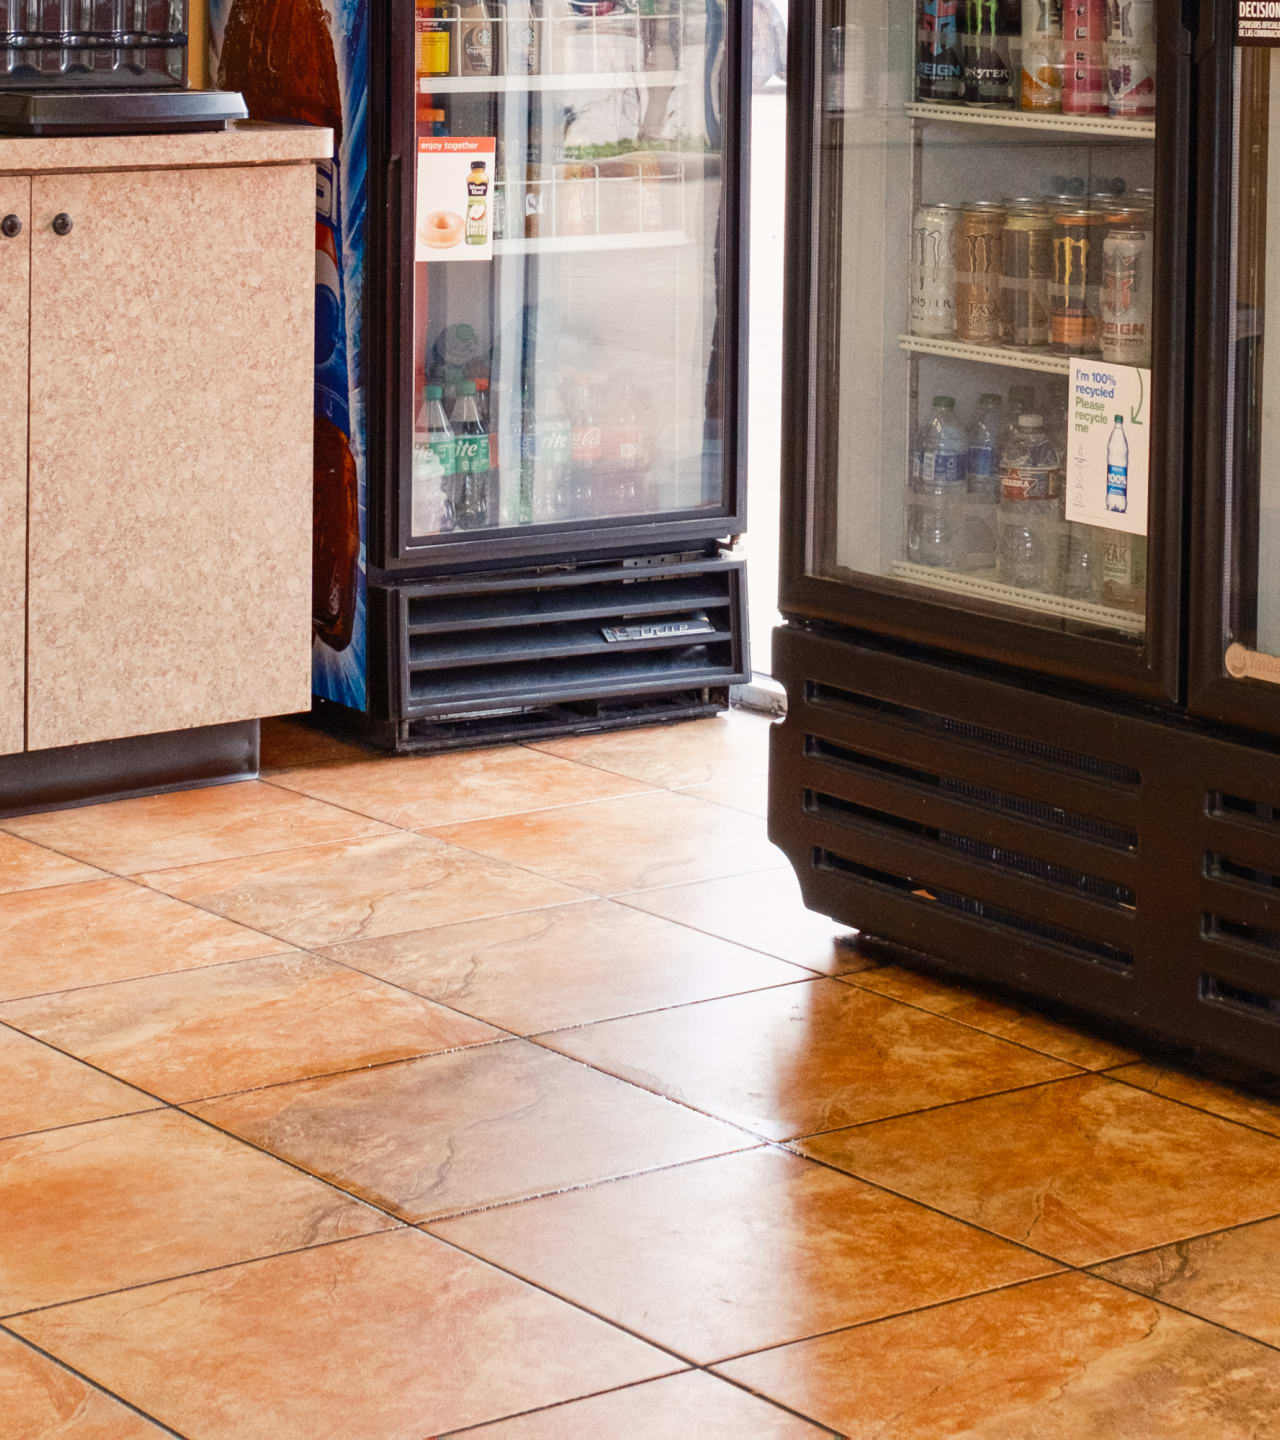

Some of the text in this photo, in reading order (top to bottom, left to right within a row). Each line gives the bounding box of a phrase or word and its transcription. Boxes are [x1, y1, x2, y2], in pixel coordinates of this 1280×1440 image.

[420, 141, 479, 151] enjoy together
[1076, 369, 1117, 386] I'm 100%
[1075, 384, 1114, 399] recycled
[1075, 397, 1105, 412] Please
[1075, 411, 1108, 425] recycle
[1075, 424, 1089, 433] me
